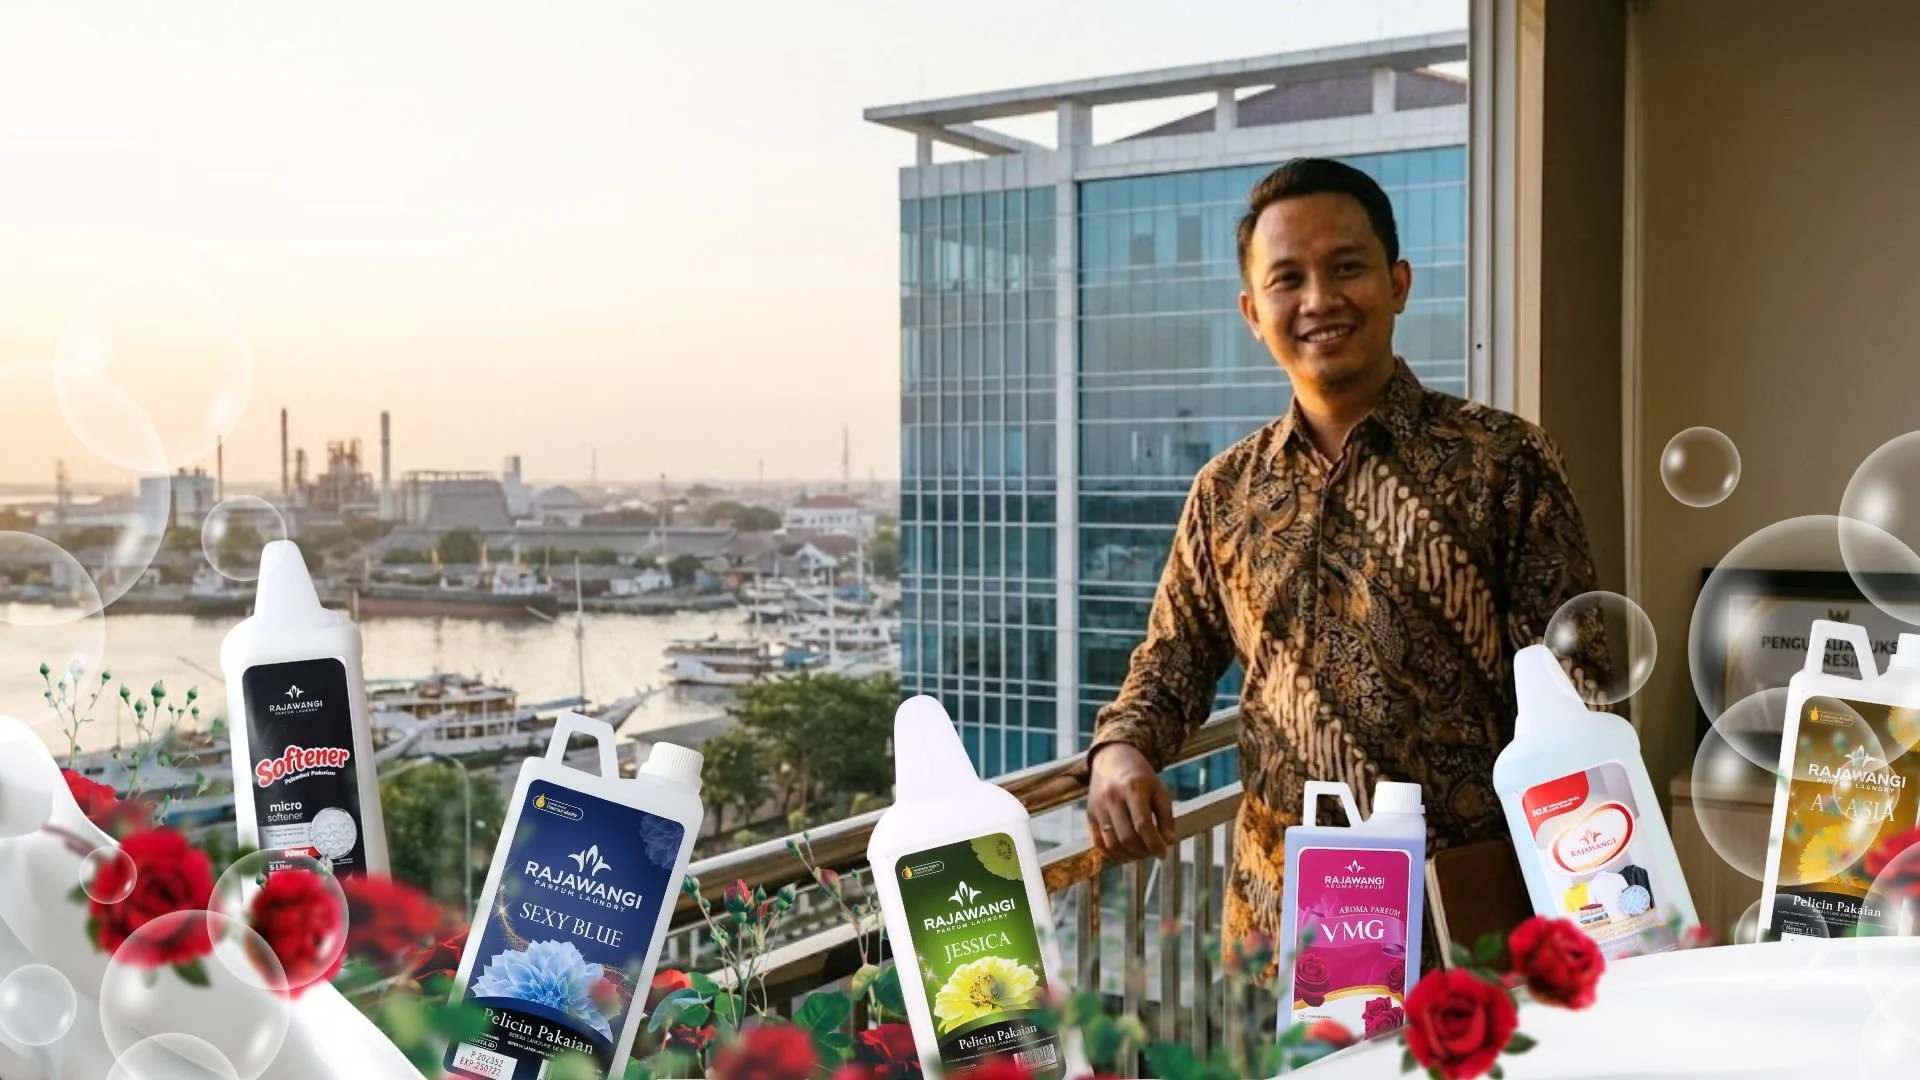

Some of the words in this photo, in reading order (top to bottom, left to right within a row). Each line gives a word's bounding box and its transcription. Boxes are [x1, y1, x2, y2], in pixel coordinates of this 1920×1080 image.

[269, 700, 323, 712] RAJAWANGI
[255, 744, 350, 788] Softener
[1808, 763, 1906, 789] RAJAWANGI
[1855, 783, 1895, 794] LAUNDRY
[267, 811, 304, 823] softener
[269, 801, 302, 812] micro
[1532, 805, 1549, 818] 10X
[1570, 837, 1617, 858] RAJAWANGI
[525, 860, 643, 909] RAJAWANGI
[1324, 876, 1384, 885] RAJAWANGI
[534, 880, 574, 897] PARFUM
[579, 894, 626, 913] LAUNDRY
[1792, 895, 1834, 911] Pelicin
[1836, 900, 1882, 918] Pakaian
[923, 898, 1016, 931] RAJAWANGI
[1339, 905, 1369, 914] AROMA
[1370, 905, 1401, 917] PARFUM
[519, 902, 572, 930] SEXY
[572, 918, 624, 948] BLUE
[936, 923, 968, 935] PARFUM
[971, 913, 1009, 926] LAUNDRY
[1320, 919, 1386, 944] VMG
[944, 931, 1011, 964] JESSICA
[484, 1007, 534, 1036] Pelicin
[537, 1025, 594, 1055] Pakaian
[958, 1034, 996, 1050] Pelicin
[997, 1024, 1038, 1041] Pakaian
